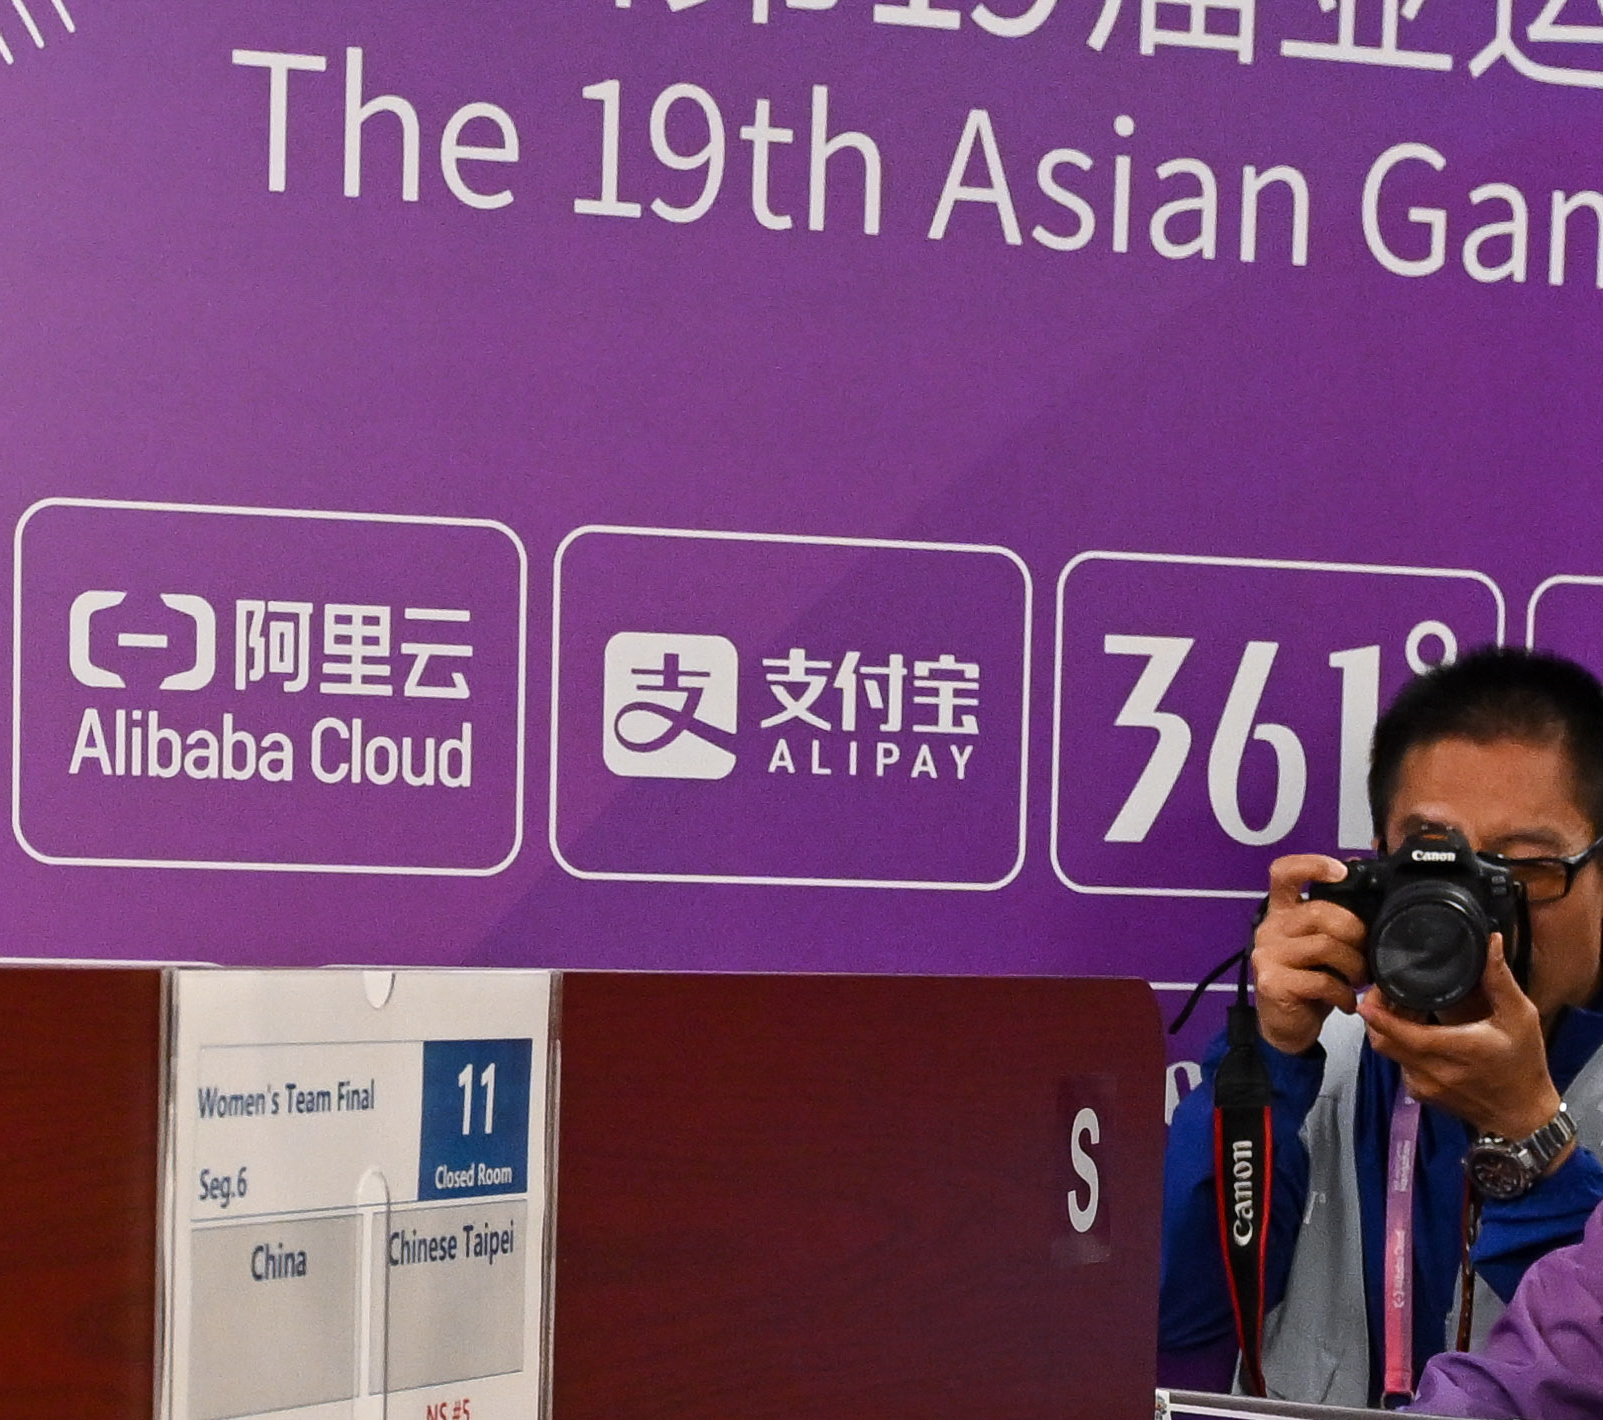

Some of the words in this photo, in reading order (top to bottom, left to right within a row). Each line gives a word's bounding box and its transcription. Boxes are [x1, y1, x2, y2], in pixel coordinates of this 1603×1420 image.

[231, 46, 521, 211] The
[573, 78, 882, 236] 19th
[926, 105, 1311, 266] Asian
[235, 599, 474, 700] 阿里云
[759, 647, 980, 735] 支付宝
[68, 707, 293, 783] Alibaba
[310, 717, 473, 788] Cloud
[767, 737, 974, 780] ALIPAY
[1411, 849, 1457, 863] Canon
[198, 1084, 280, 1119] Women's
[285, 1082, 332, 1114] Team
[336, 1078, 376, 1112] Final
[457, 1062, 497, 1136] 11
[199, 1166, 248, 1210] Seg.6
[435, 1162, 475, 1190] Closed
[477, 1163, 513, 1187] Room
[1067, 1107, 1100, 1233] S
[1232, 1138, 1254, 1248] Canon
[251, 1242, 308, 1282] China
[389, 1229, 458, 1267] Chinese
[462, 1219, 515, 1266] Taipei
